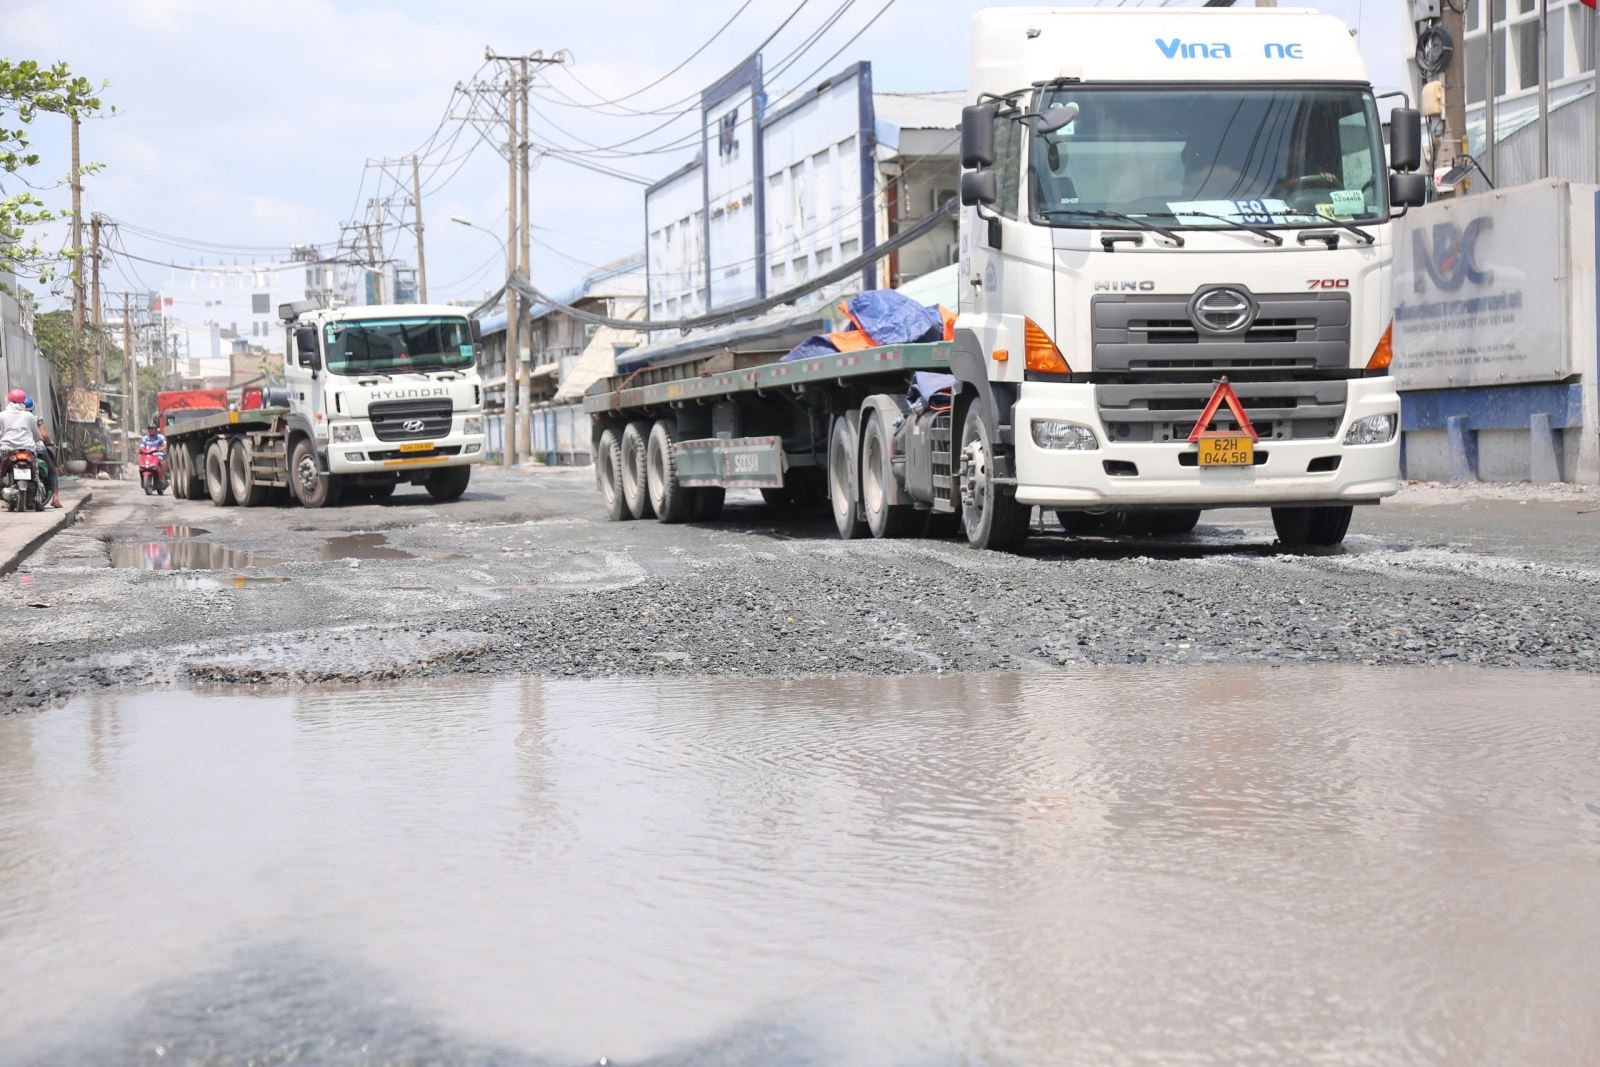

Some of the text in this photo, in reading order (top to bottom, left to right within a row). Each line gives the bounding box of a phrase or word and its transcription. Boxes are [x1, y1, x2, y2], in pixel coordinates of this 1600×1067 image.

[1155, 38, 1231, 59] Vina
[1094, 280, 1155, 291] HINO
[1306, 279, 1349, 289] 700
[371, 387, 449, 399] HYUNDAI
[1214, 439, 1238, 451] 62H
[1204, 452, 1247, 464] 044.58
